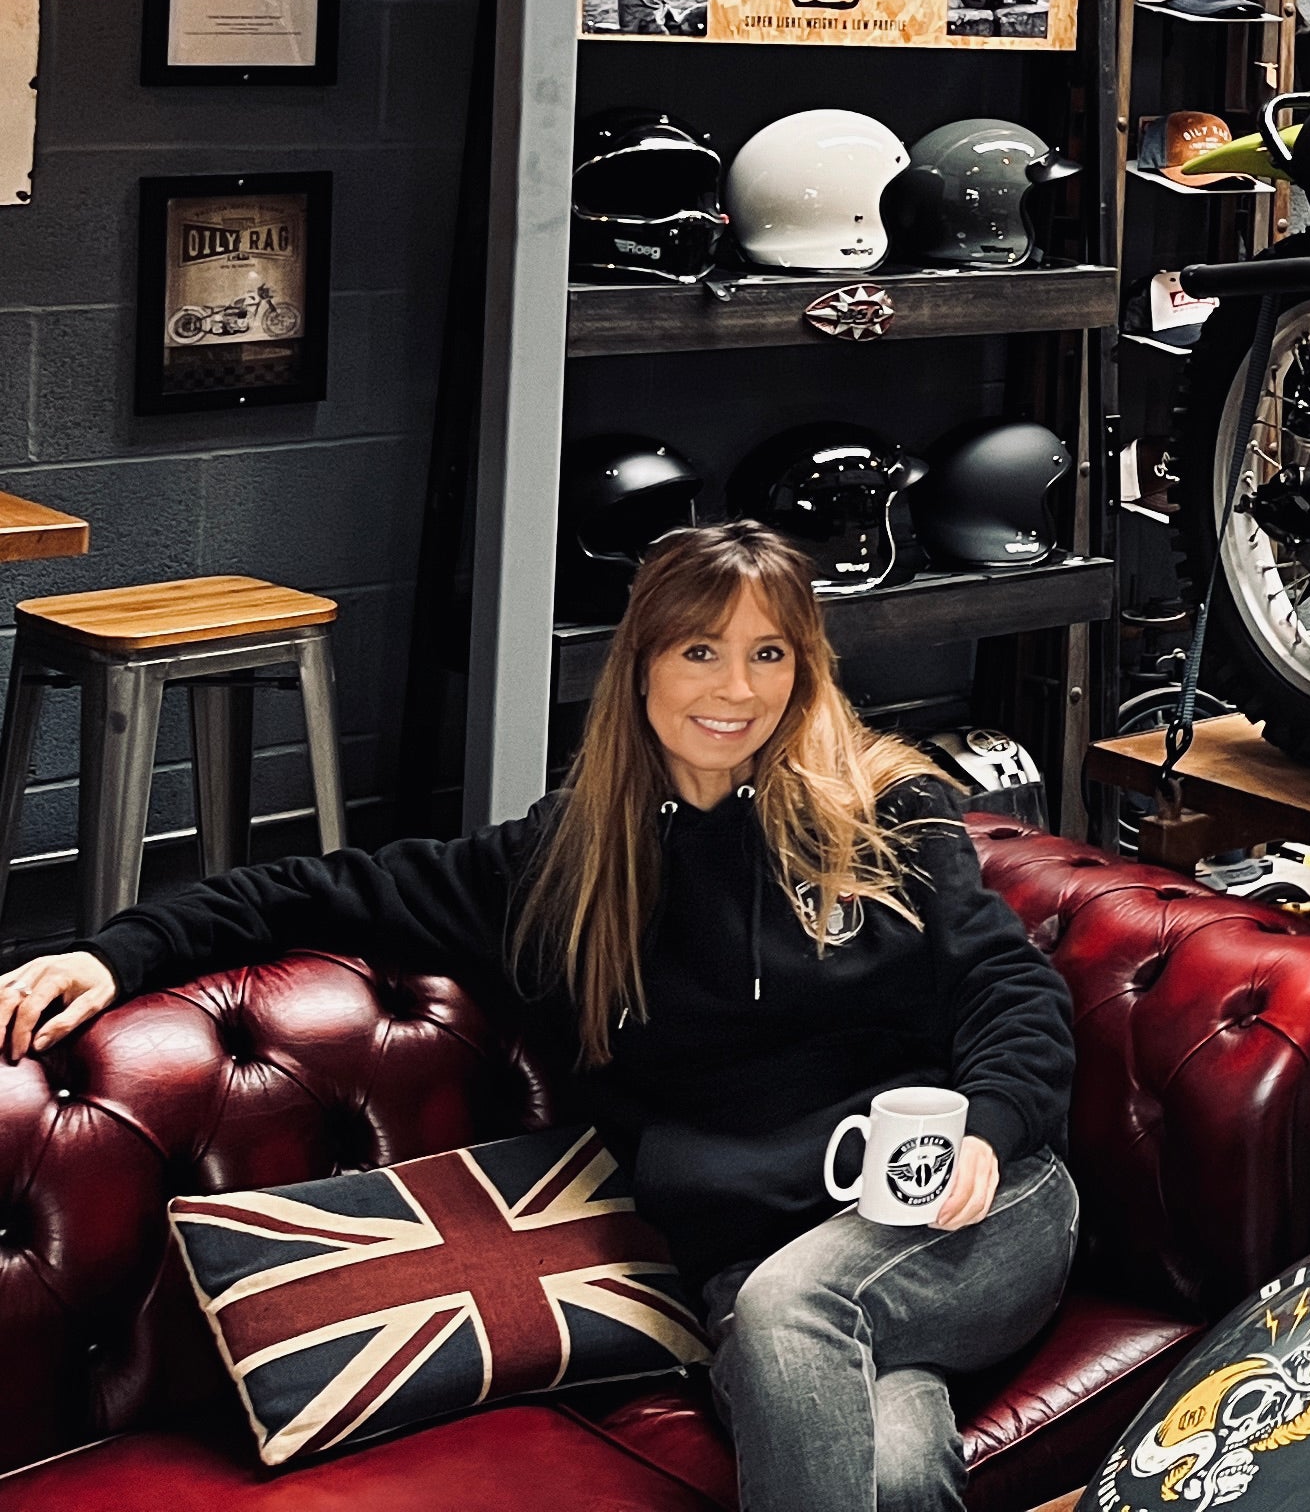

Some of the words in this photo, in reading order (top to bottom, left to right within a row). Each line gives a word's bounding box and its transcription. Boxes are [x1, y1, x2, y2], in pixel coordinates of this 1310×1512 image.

[745, 16, 773, 28] SUPER
[777, 17, 802, 29] LIGHT
[806, 17, 839, 30] WEIGHT
[852, 19, 869, 31] LOW
[1182, 125, 1209, 141] OILY
[188, 229, 237, 257] OILY
[249, 225, 290, 252] RAG
[627, 239, 661, 260] Roeg
